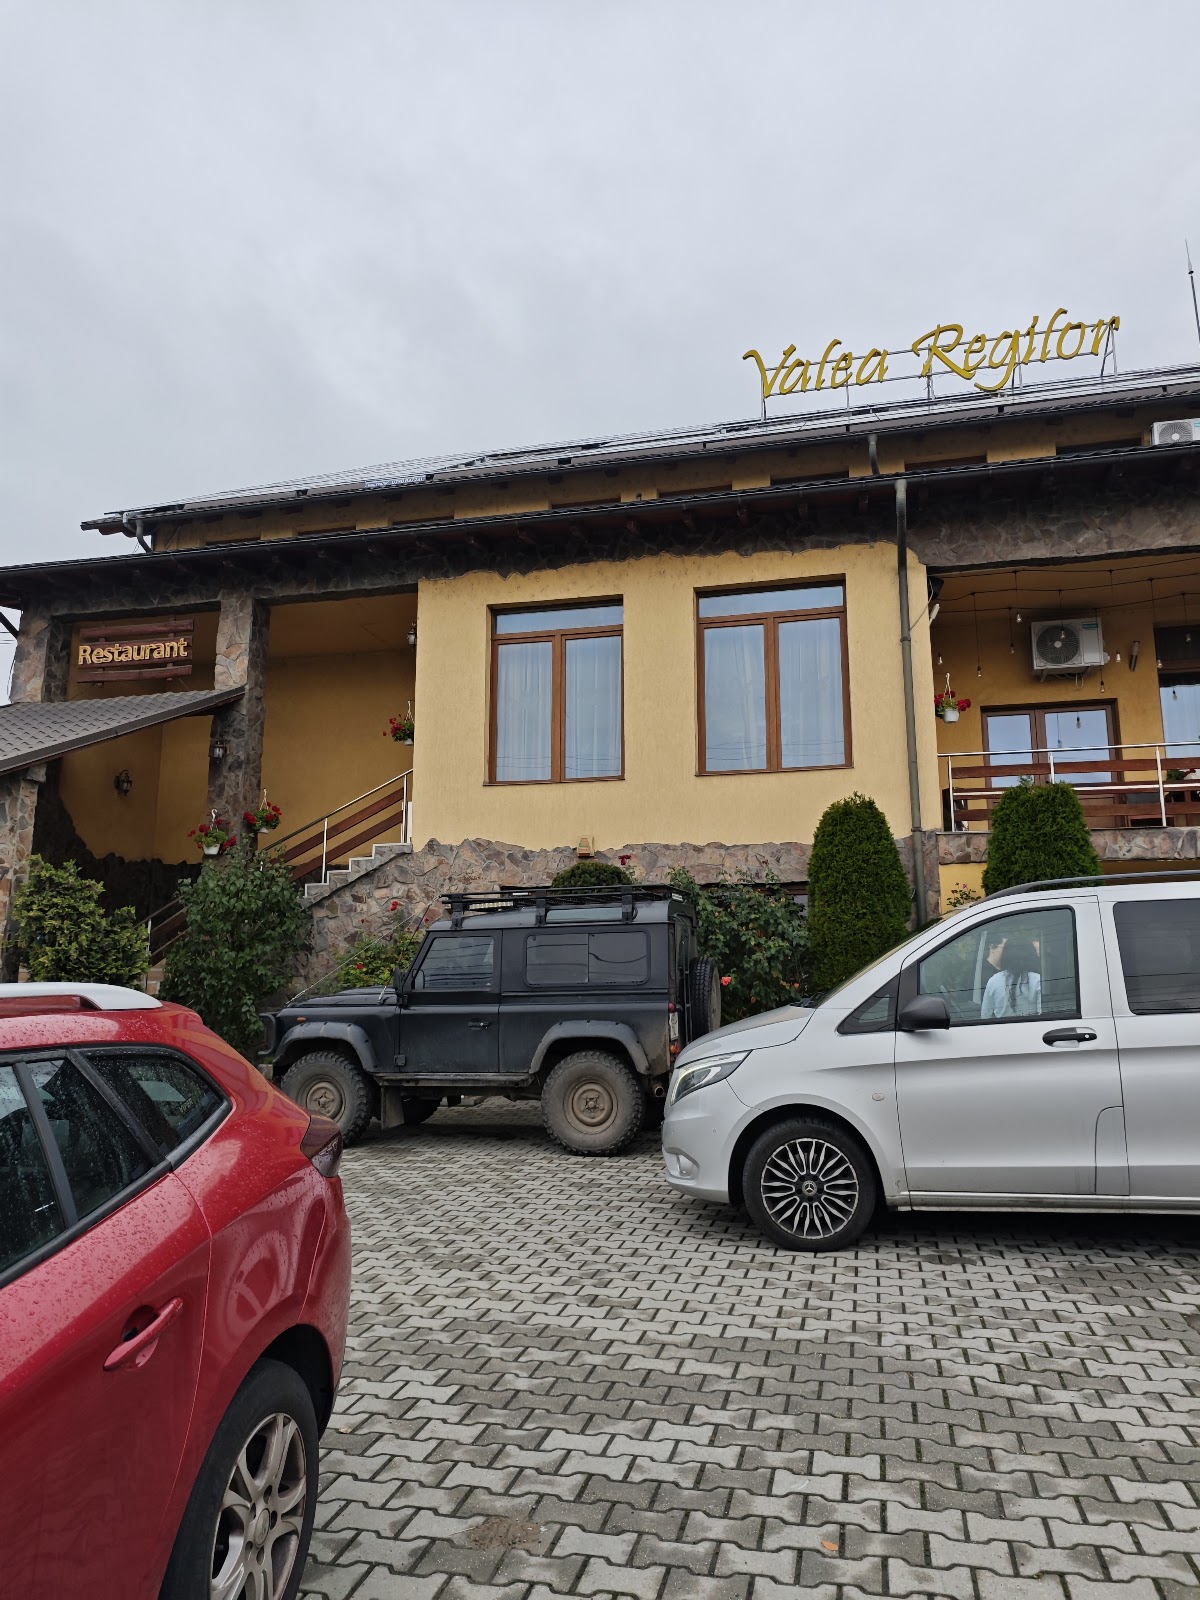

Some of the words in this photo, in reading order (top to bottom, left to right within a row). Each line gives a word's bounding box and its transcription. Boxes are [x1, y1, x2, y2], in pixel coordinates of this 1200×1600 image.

[743, 339, 888, 398] Valea
[912, 307, 1120, 391] Regilor
[78, 638, 188, 665] Restaurant
